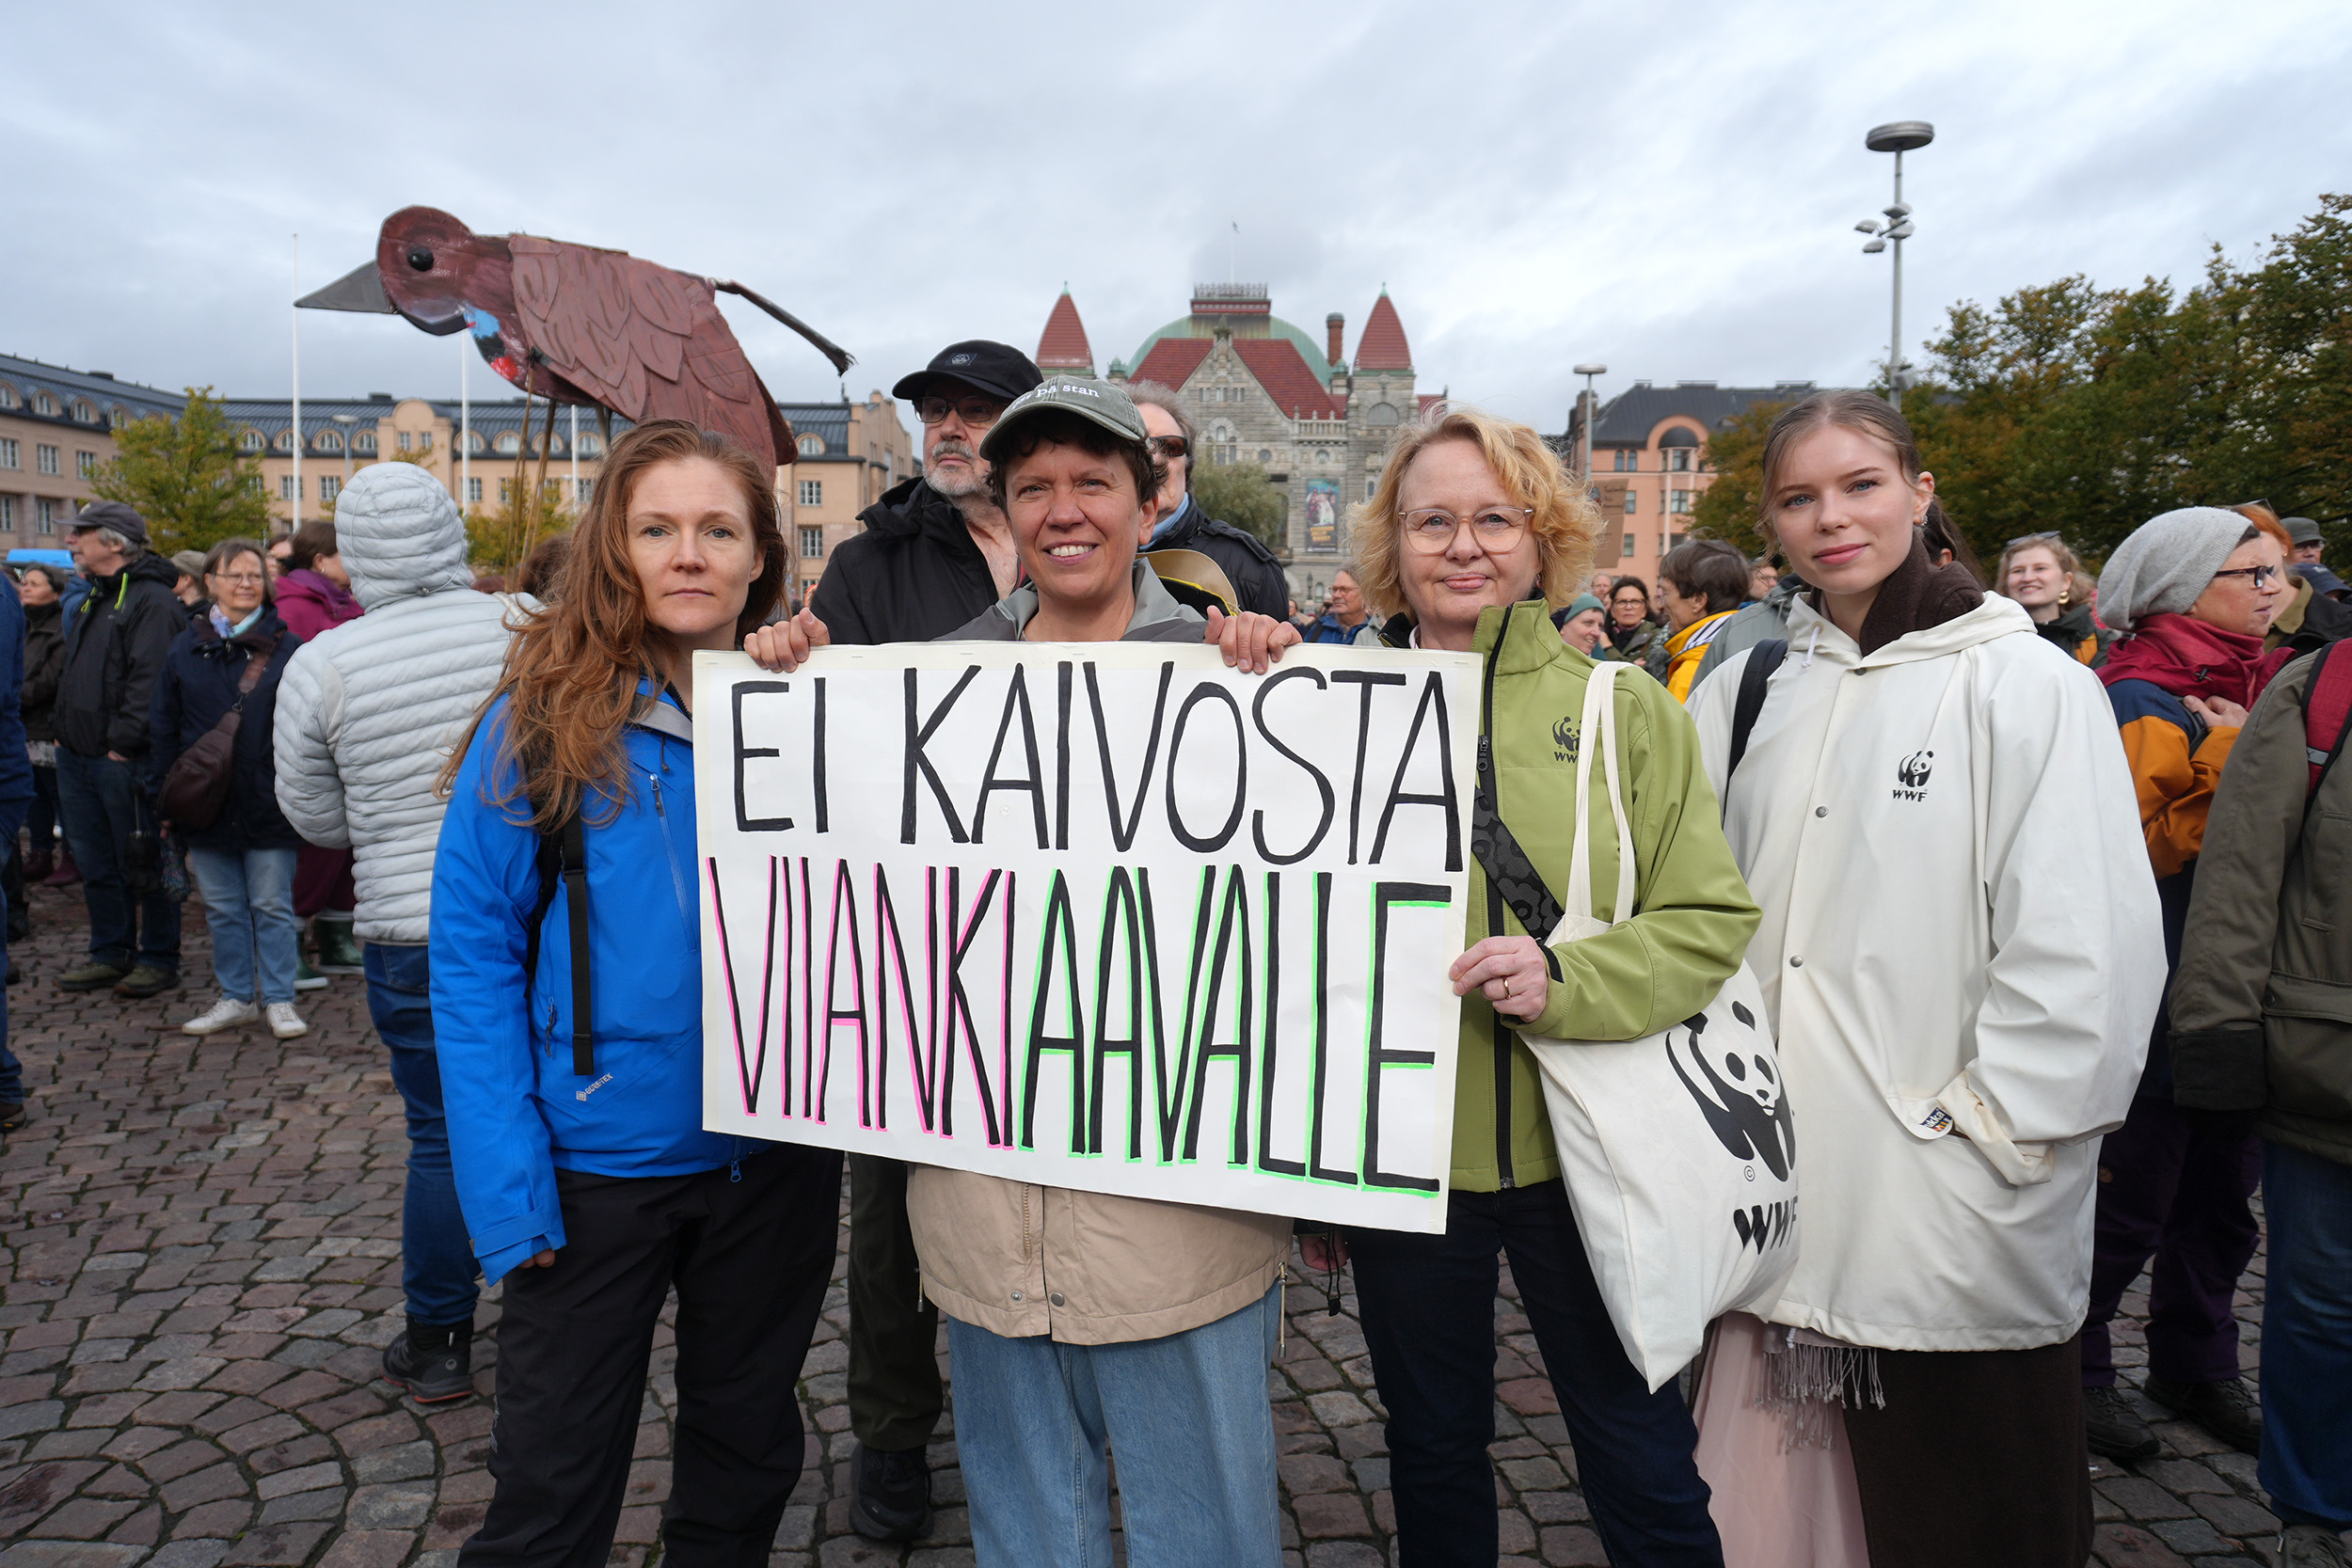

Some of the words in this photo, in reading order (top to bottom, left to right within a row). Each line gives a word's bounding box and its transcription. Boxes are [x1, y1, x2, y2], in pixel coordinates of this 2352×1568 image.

[1062, 384, 1100, 398] stan
[731, 677, 829, 833] EI
[900, 661, 1463, 872] KAIVOSTA
[1554, 752, 1578, 764] WW
[1892, 789, 1928, 802] WWF
[705, 855, 1452, 1197] VIIANKIAAVALLE
[1733, 1195, 1799, 1255] WWF
